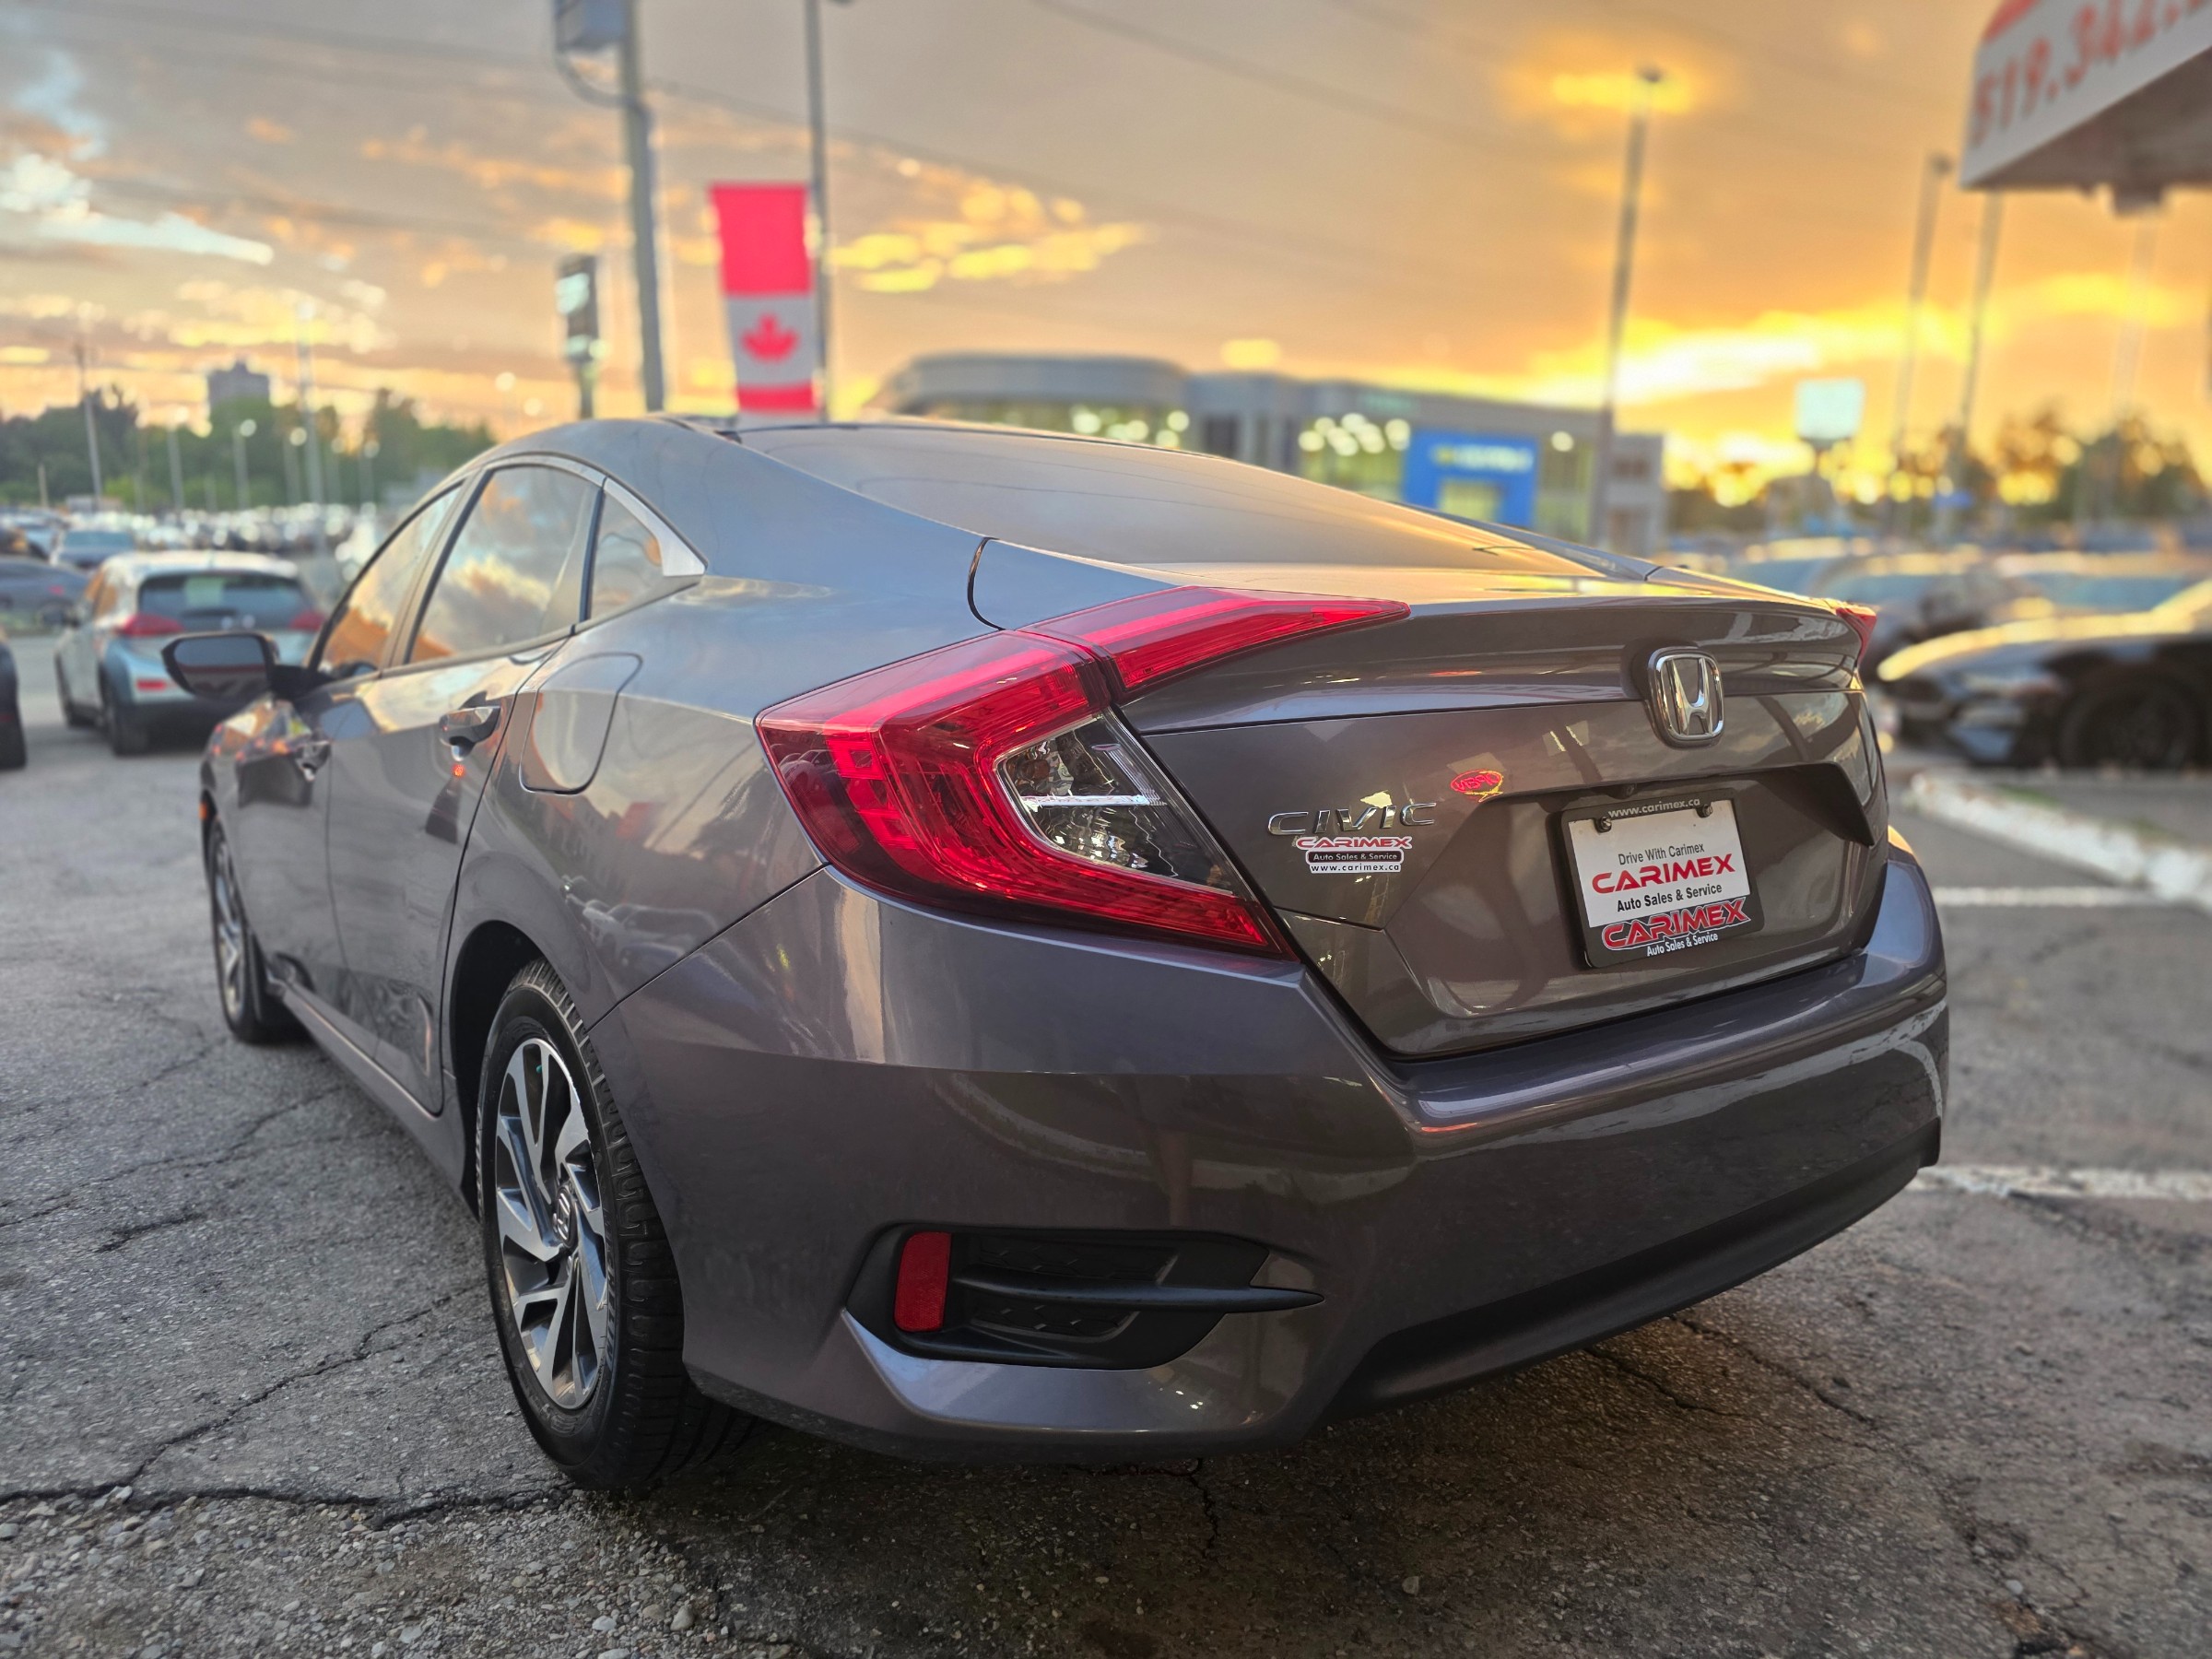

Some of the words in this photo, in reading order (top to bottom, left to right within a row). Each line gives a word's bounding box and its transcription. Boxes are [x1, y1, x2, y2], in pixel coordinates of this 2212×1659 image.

[1267, 802, 1437, 836] CIVIC
[1608, 798, 1700, 818] www.carimex.ca
[1297, 837, 1412, 849] CARIMEX
[1618, 851, 1643, 865] Drive
[1645, 847, 1666, 861] With
[1668, 842, 1705, 857] Carimex
[1311, 863, 1399, 871] www.carimex.ca
[1335, 853, 1358, 861] Sales
[1592, 853, 1735, 894] CARIMEX
[1617, 898, 1641, 912] Auto
[1644, 892, 1673, 907] Sales
[1676, 889, 1684, 900] &
[1686, 884, 1722, 899] Service
[1603, 898, 1750, 949] CARIMEX
[1647, 945, 1664, 957] Auto
[1665, 938, 1685, 952] Sales
[1686, 937, 1692, 947] &
[1693, 932, 1718, 946] Service
